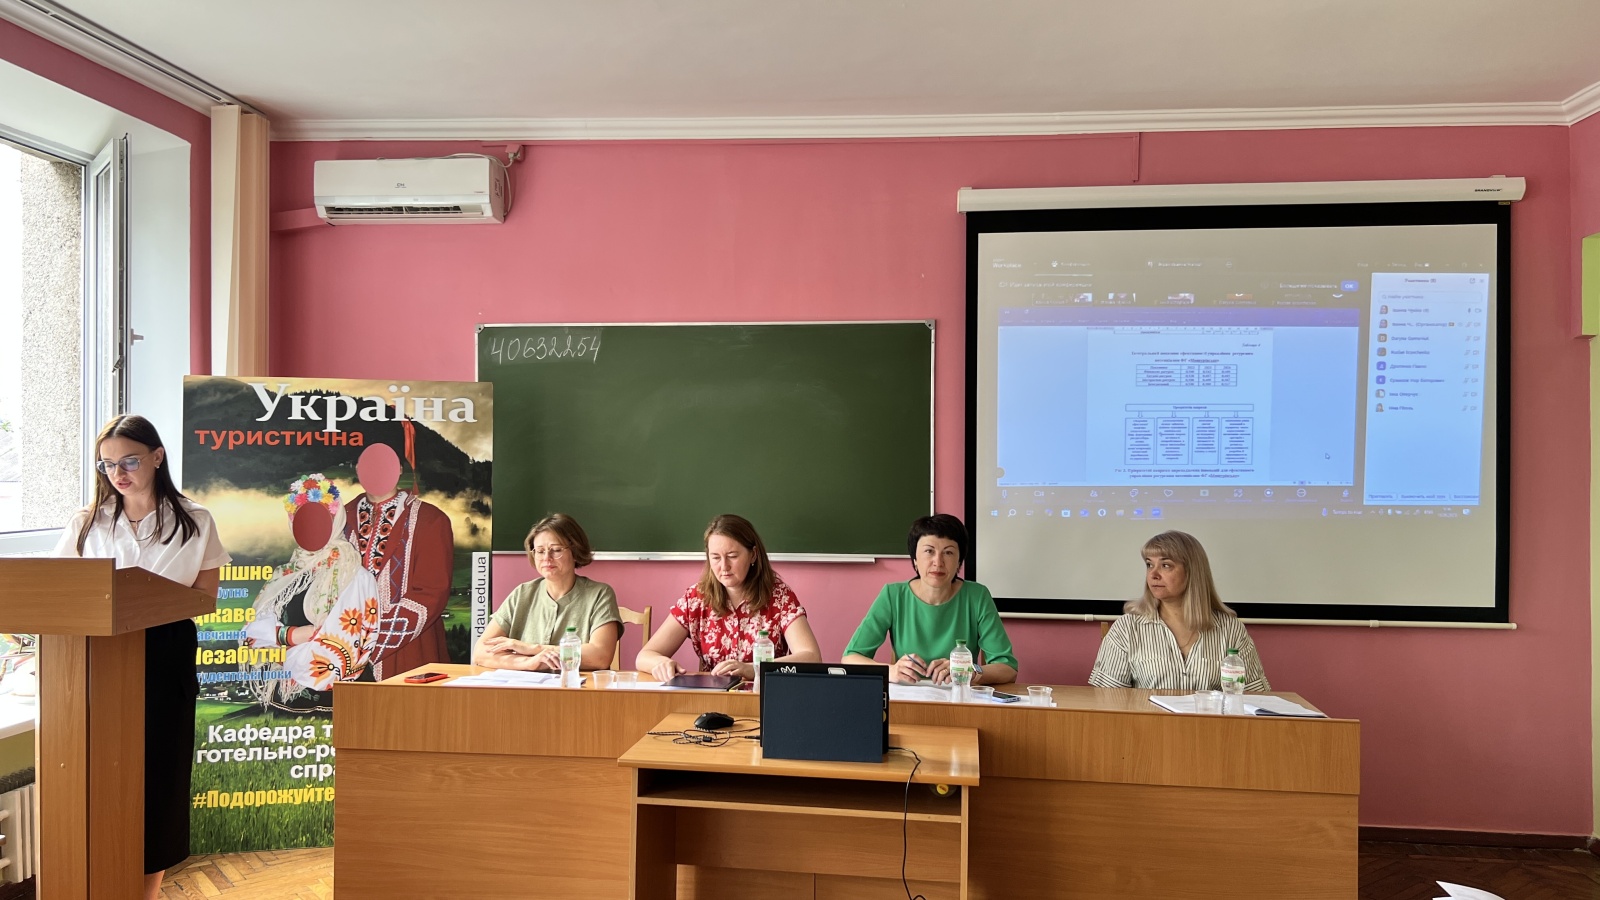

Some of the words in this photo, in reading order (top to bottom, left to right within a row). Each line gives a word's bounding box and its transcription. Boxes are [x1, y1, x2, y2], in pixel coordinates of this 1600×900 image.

[491, 335, 600, 365] 40632254
[249, 382, 477, 433] Україна
[194, 429, 364, 450] туристична
[474, 556, 486, 637] dau.edu.ua
[197, 630, 247, 642] авчання
[197, 671, 262, 683] тудентські
[208, 724, 315, 746] Кафедра
[290, 763, 336, 781] спр
[192, 784, 335, 809] #Подорожуйте
